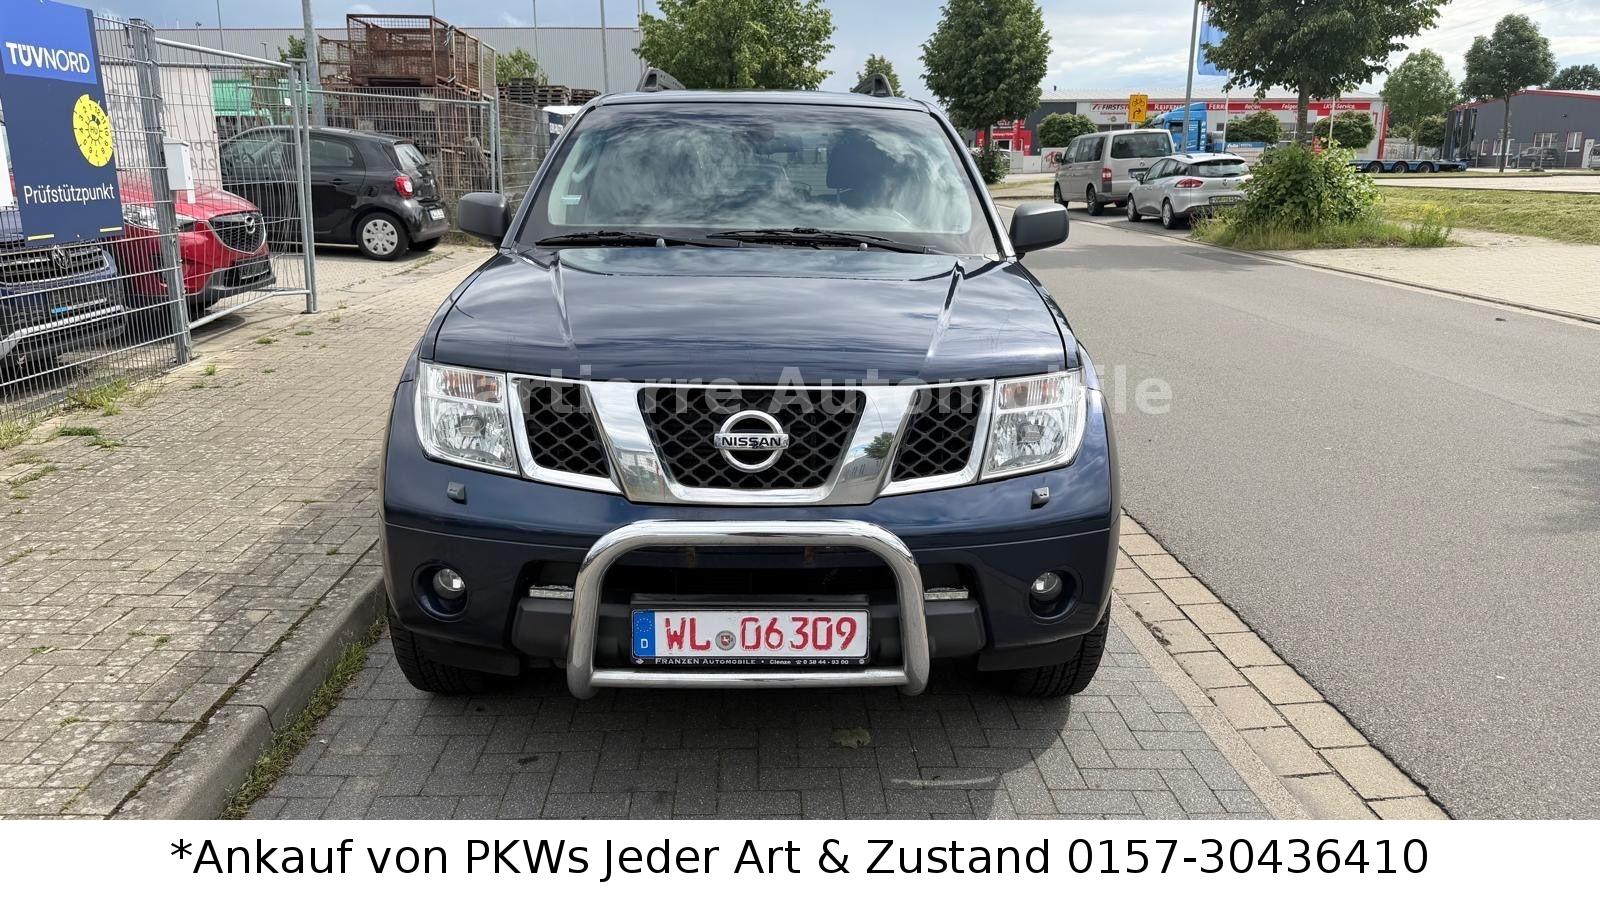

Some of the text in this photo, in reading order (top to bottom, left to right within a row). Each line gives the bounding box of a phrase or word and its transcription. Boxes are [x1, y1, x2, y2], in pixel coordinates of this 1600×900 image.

[23, 183, 115, 206] Prüfstützpunkt
[721, 436, 781, 447] NISSAN
[664, 617, 858, 651] WL 06309
[640, 638, 649, 649] D
